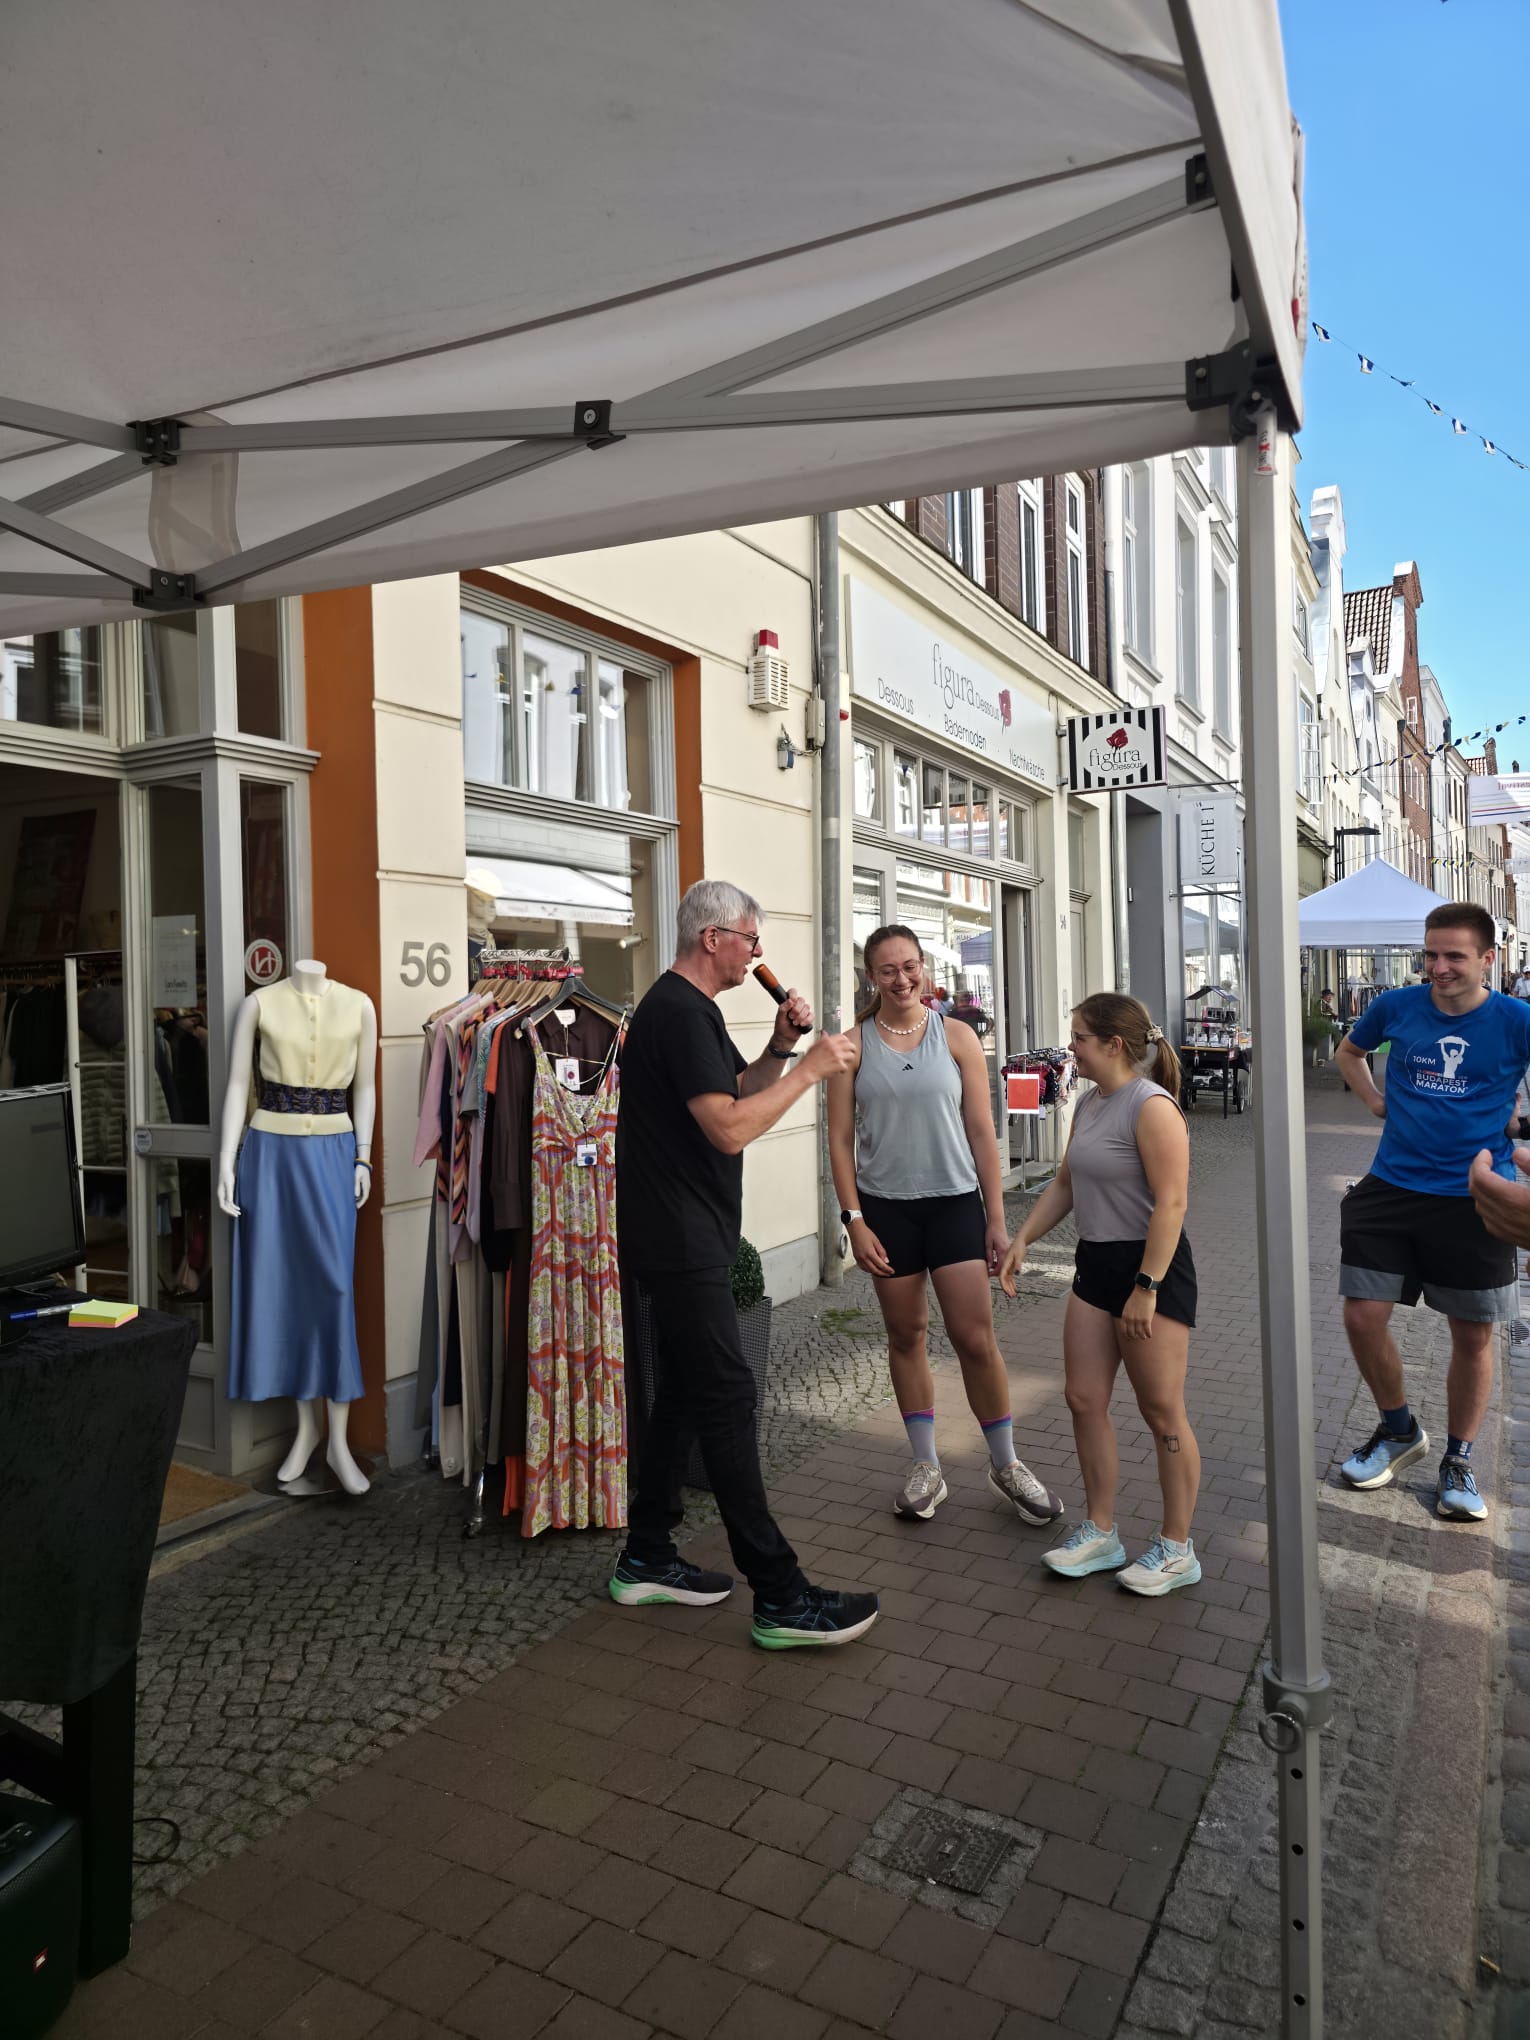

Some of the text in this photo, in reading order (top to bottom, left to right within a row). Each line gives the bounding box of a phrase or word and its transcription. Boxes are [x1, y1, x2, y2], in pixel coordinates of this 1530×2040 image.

[932, 643, 975, 710] figura
[877, 677, 914, 715] Dessous
[944, 713, 987, 750] Bademoden
[1089, 747, 1141, 772] figura
[1198, 818, 1216, 876] KÜCHE
[399, 940, 452, 988] 56
[1412, 1055, 1436, 1065] 10KM
[1416, 1072, 1469, 1088] BUDAPEST
